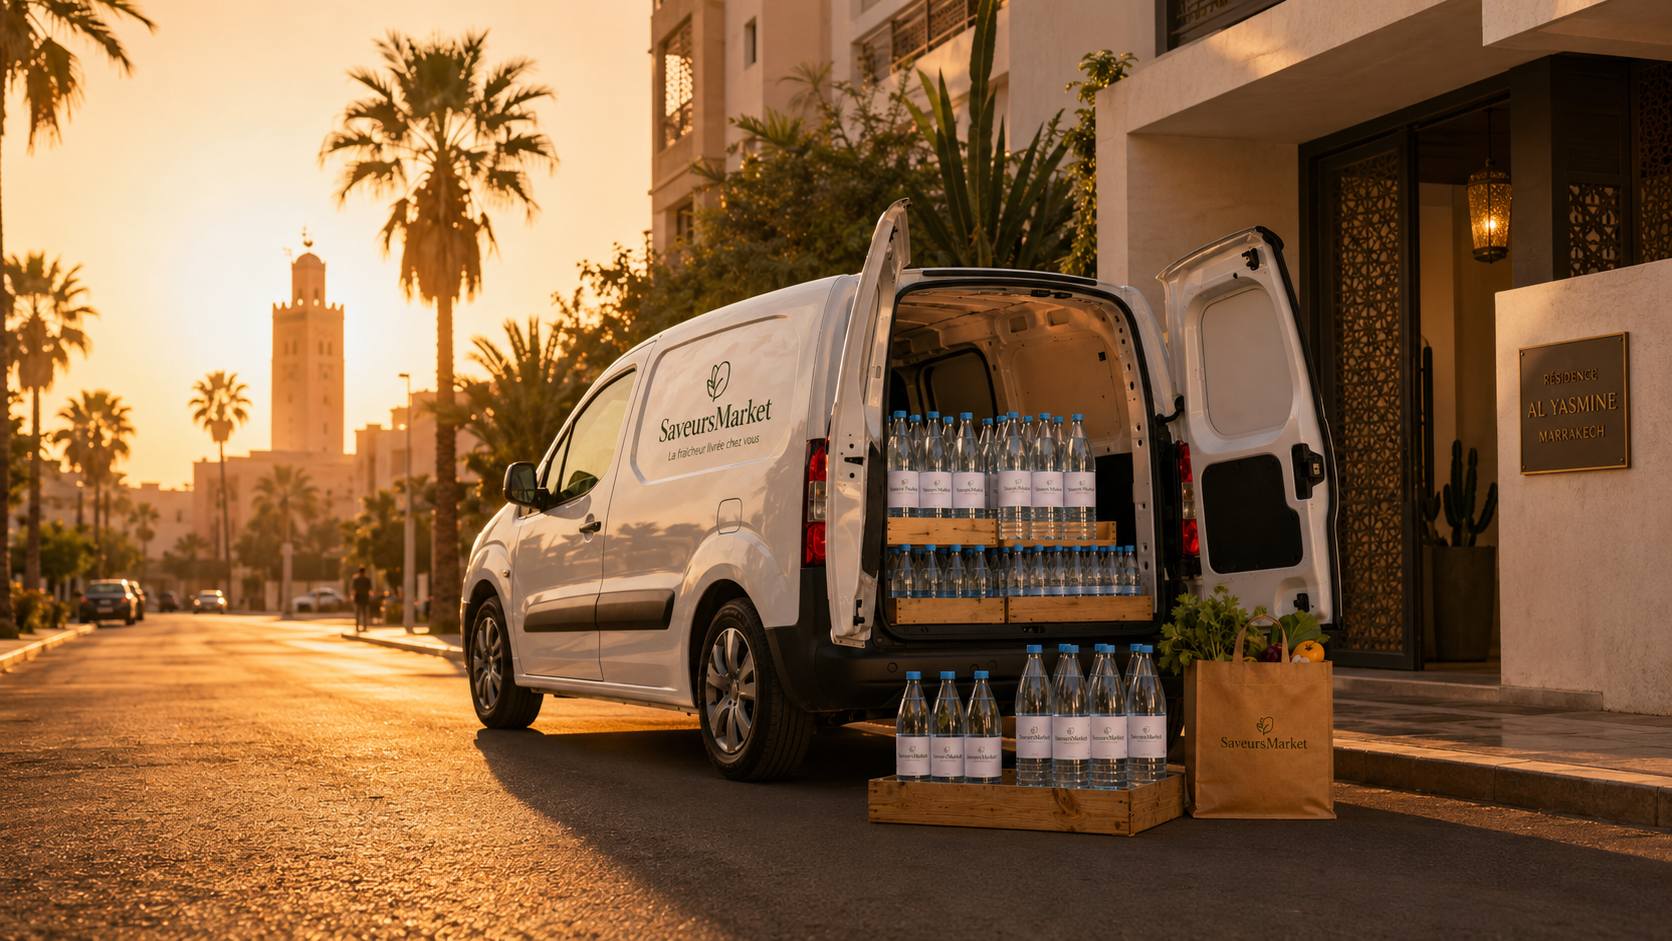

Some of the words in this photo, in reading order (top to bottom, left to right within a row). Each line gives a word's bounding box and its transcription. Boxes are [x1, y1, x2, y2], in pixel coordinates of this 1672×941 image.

[1543, 368, 1598, 386] RÉSIDENCE
[1527, 400, 1546, 418] AL
[1550, 392, 1618, 415] YASMINE
[659, 399, 772, 443] SaveursMarket
[1539, 425, 1605, 443] MARRAKECH
[668, 451, 676, 461] La
[726, 437, 742, 449] chez
[743, 435, 760, 446] vous
[1220, 736, 1308, 750] SaveursMarket
